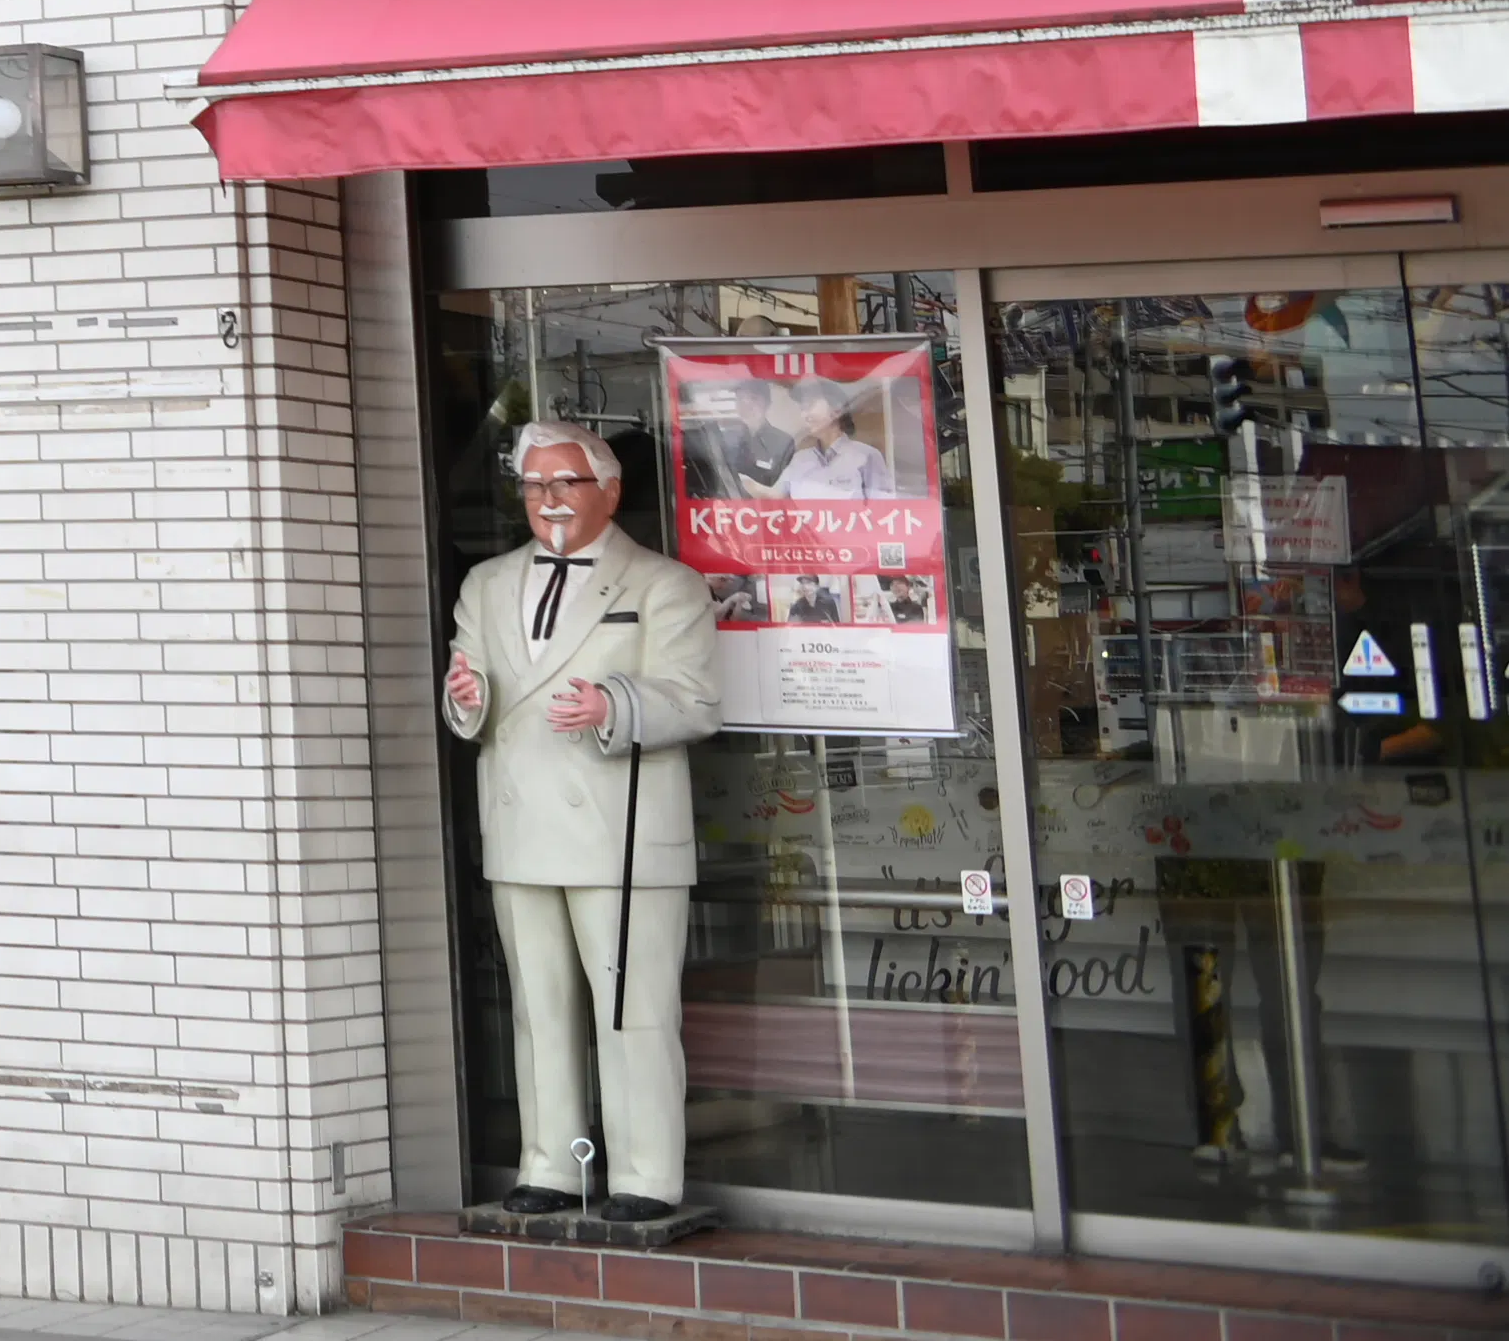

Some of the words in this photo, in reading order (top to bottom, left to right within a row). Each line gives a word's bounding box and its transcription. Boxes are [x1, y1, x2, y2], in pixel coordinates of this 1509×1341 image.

[690, 506, 923, 536] KFCでアルバイト
[761, 548, 835, 562] 詳しくはこちら
